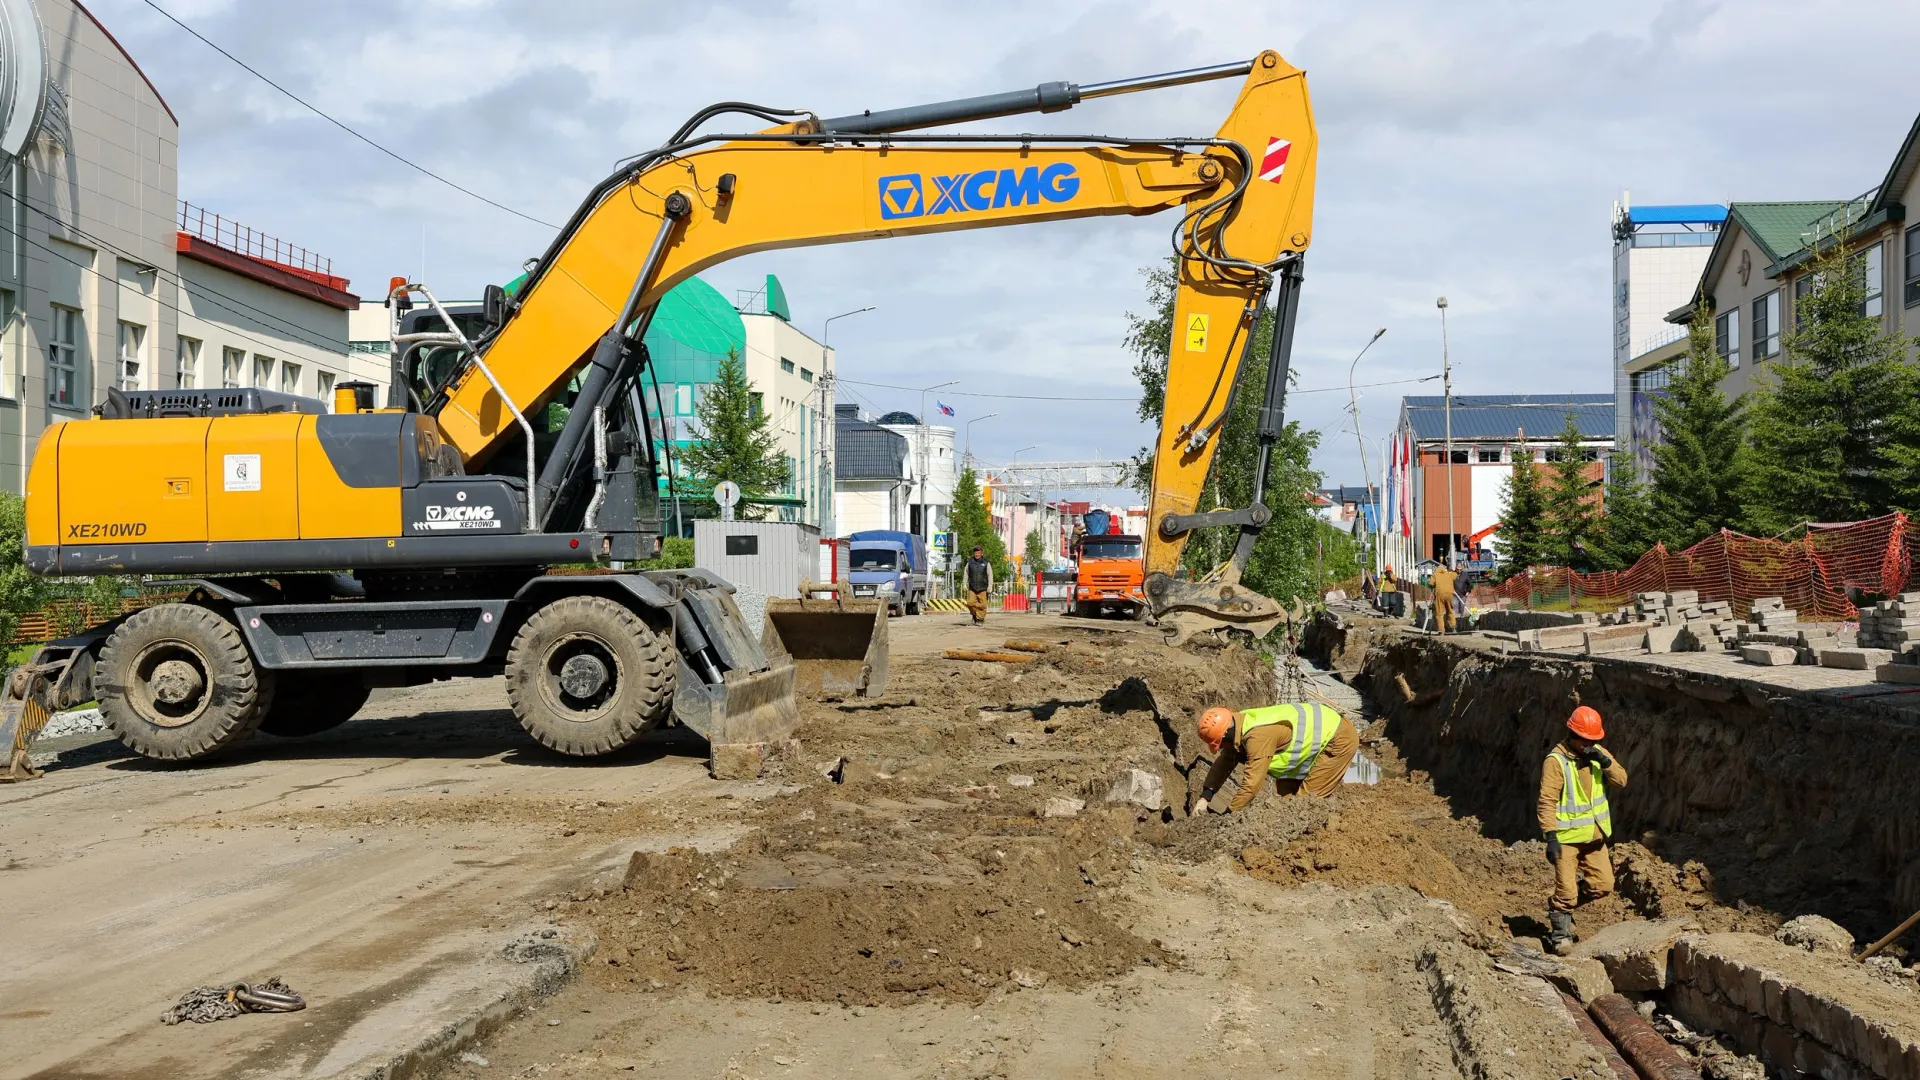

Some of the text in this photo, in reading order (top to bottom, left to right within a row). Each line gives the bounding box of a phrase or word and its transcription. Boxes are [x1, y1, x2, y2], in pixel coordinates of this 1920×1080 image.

[925, 162, 1080, 215] XCMG
[442, 506, 494, 521] XCMG
[68, 523, 147, 538] XE210WD
